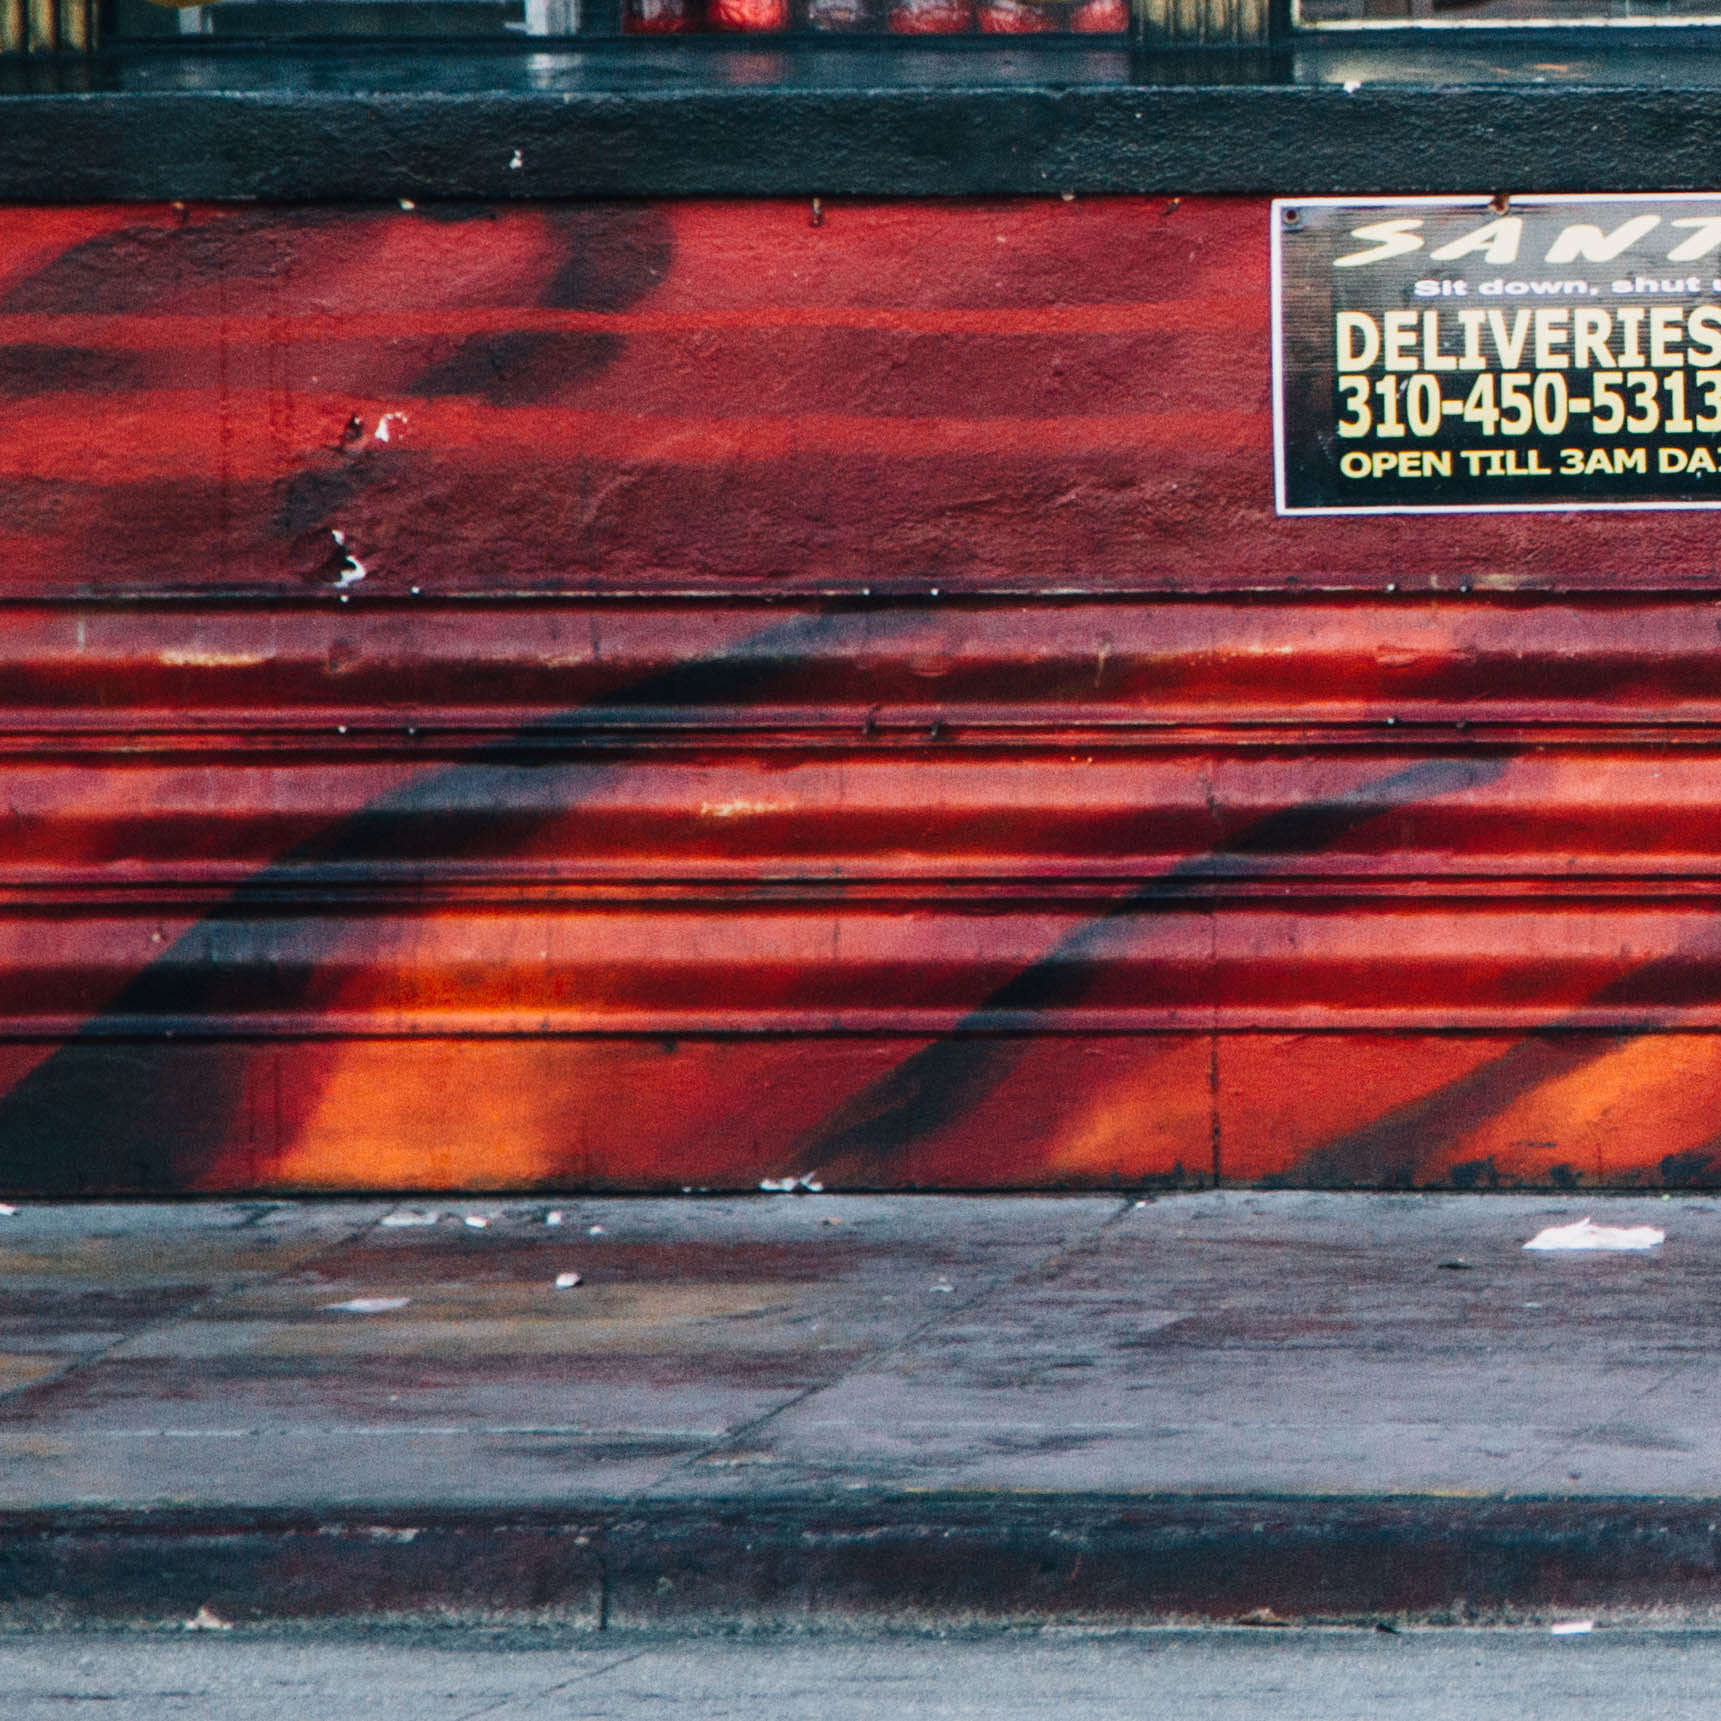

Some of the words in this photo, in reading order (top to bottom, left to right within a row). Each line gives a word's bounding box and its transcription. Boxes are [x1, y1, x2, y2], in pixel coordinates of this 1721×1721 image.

[1413, 278, 1468, 297] Sit
[1477, 277, 1599, 297] down,
[1610, 275, 1701, 295] shut
[1339, 450, 1452, 479] OPEN
[1459, 447, 1552, 477] TILL
[1559, 446, 1648, 476] 3AM
